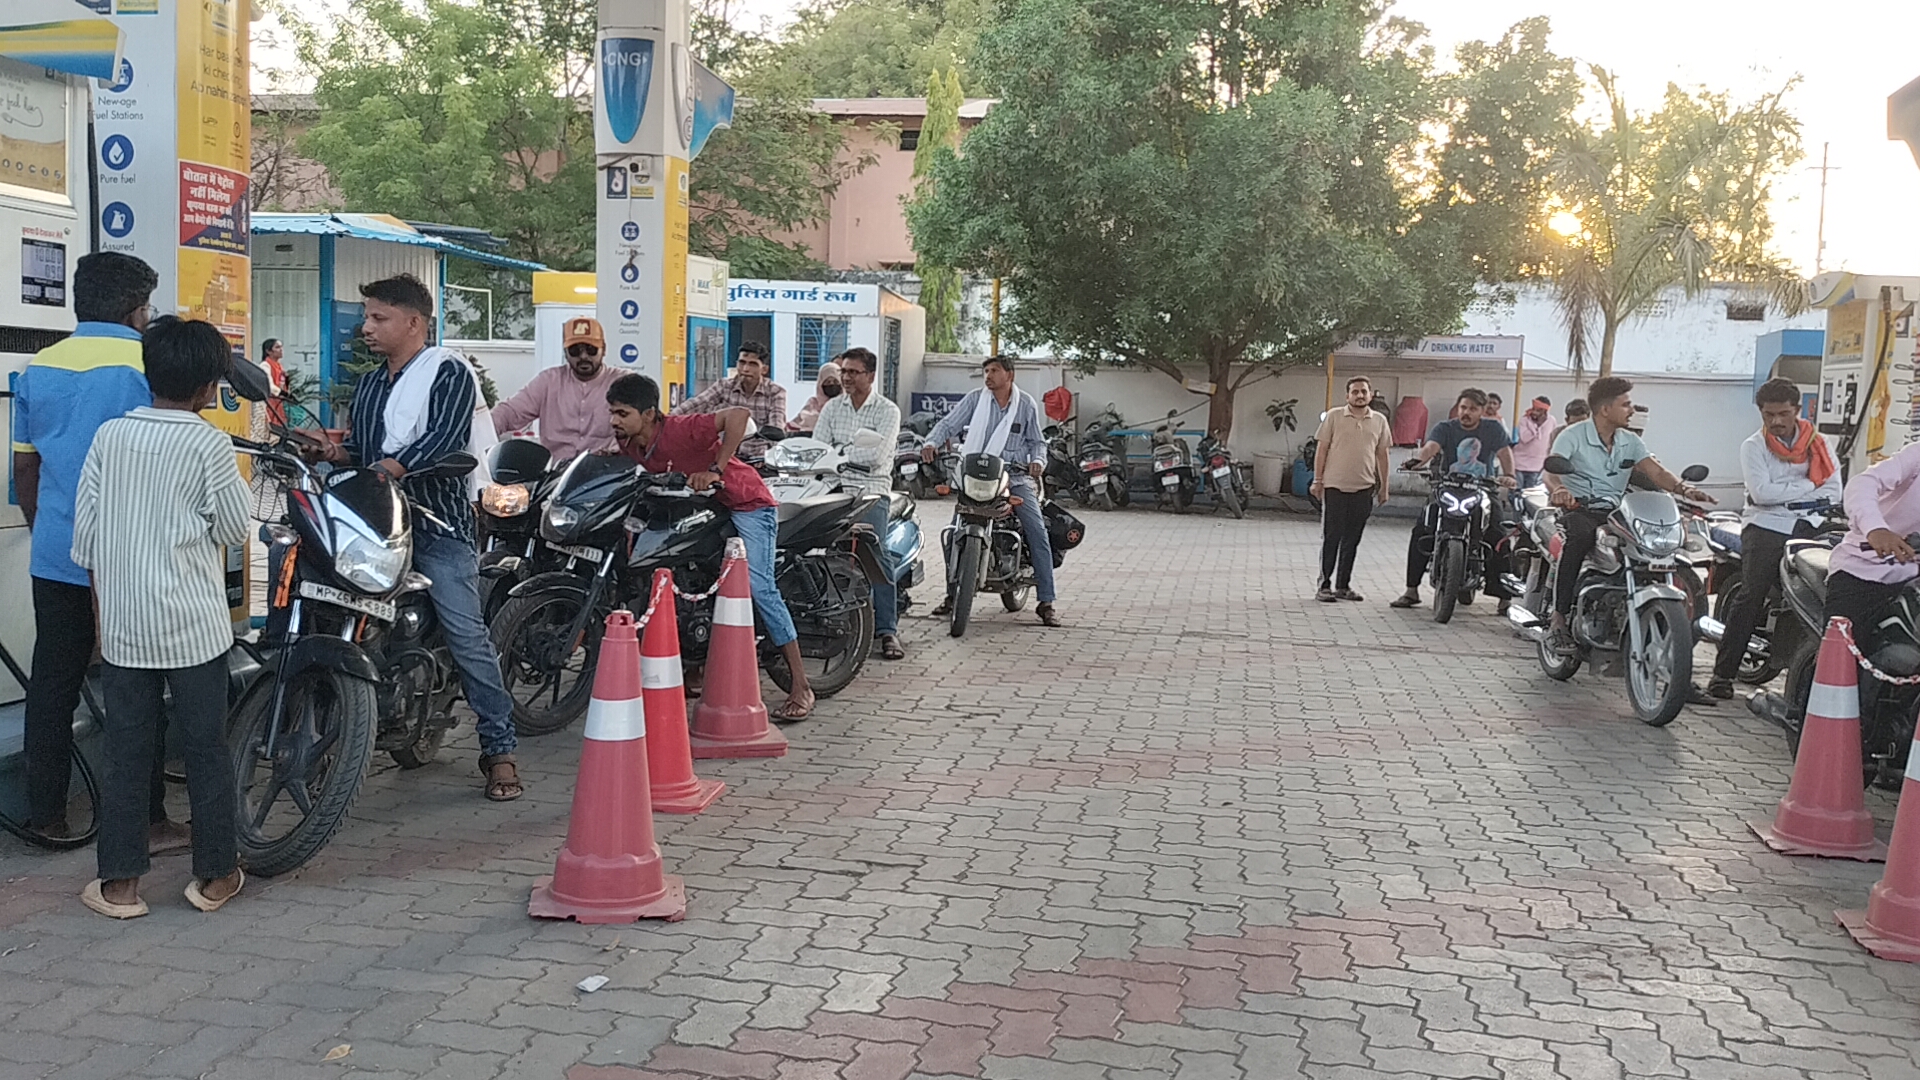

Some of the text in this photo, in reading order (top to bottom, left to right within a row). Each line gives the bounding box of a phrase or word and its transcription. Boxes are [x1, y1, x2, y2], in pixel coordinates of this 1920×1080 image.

[608, 52, 640, 66] CNG
[98, 96, 137, 109] New-age
[111, 110, 144, 120] Stations
[100, 172, 137, 184] Pure fuel
[102, 241, 135, 251] Assured
[781, 287, 820, 301] गार्ड
[823, 291, 857, 303] रूम
[1431, 343, 1467, 353] DRINKING
[1469, 344, 1494, 354] WATER
